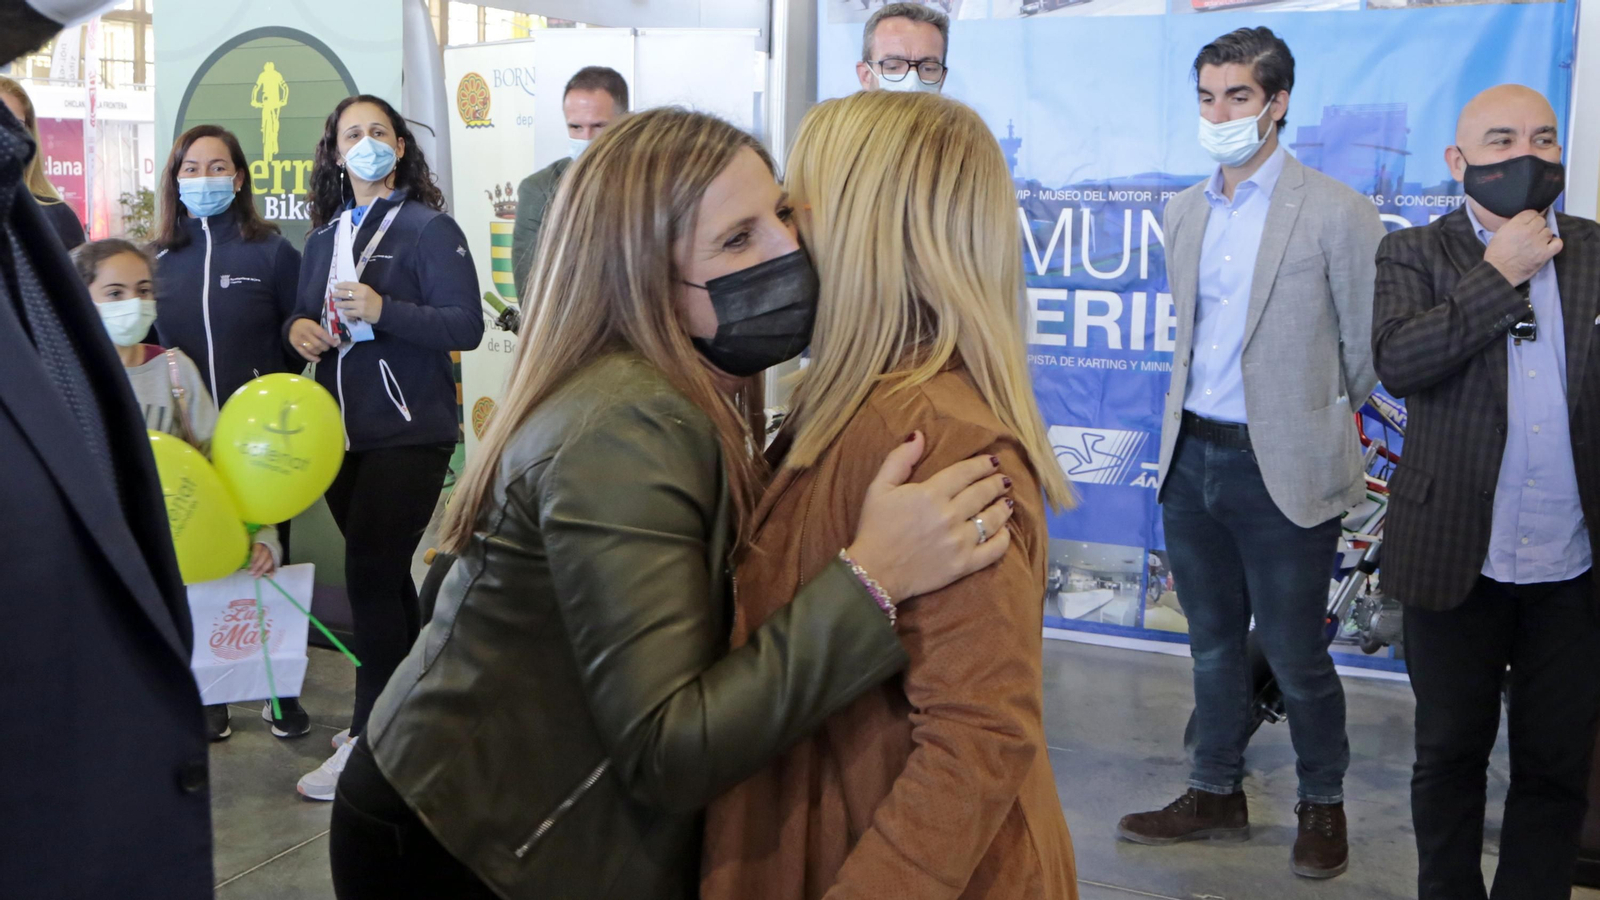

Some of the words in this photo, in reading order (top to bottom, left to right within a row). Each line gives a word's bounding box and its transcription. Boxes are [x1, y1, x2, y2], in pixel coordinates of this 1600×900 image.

[516, 113, 534, 128] dep
[1039, 189, 1081, 201] MUSEO
[1084, 190, 1107, 202] DEL
[1108, 190, 1152, 202] MOTOR
[487, 337, 500, 352] de
[1027, 354, 1058, 366] PISTA
[1060, 356, 1075, 367] DE
[1078, 357, 1127, 370] KARTING
[1130, 360, 1138, 370] Y
